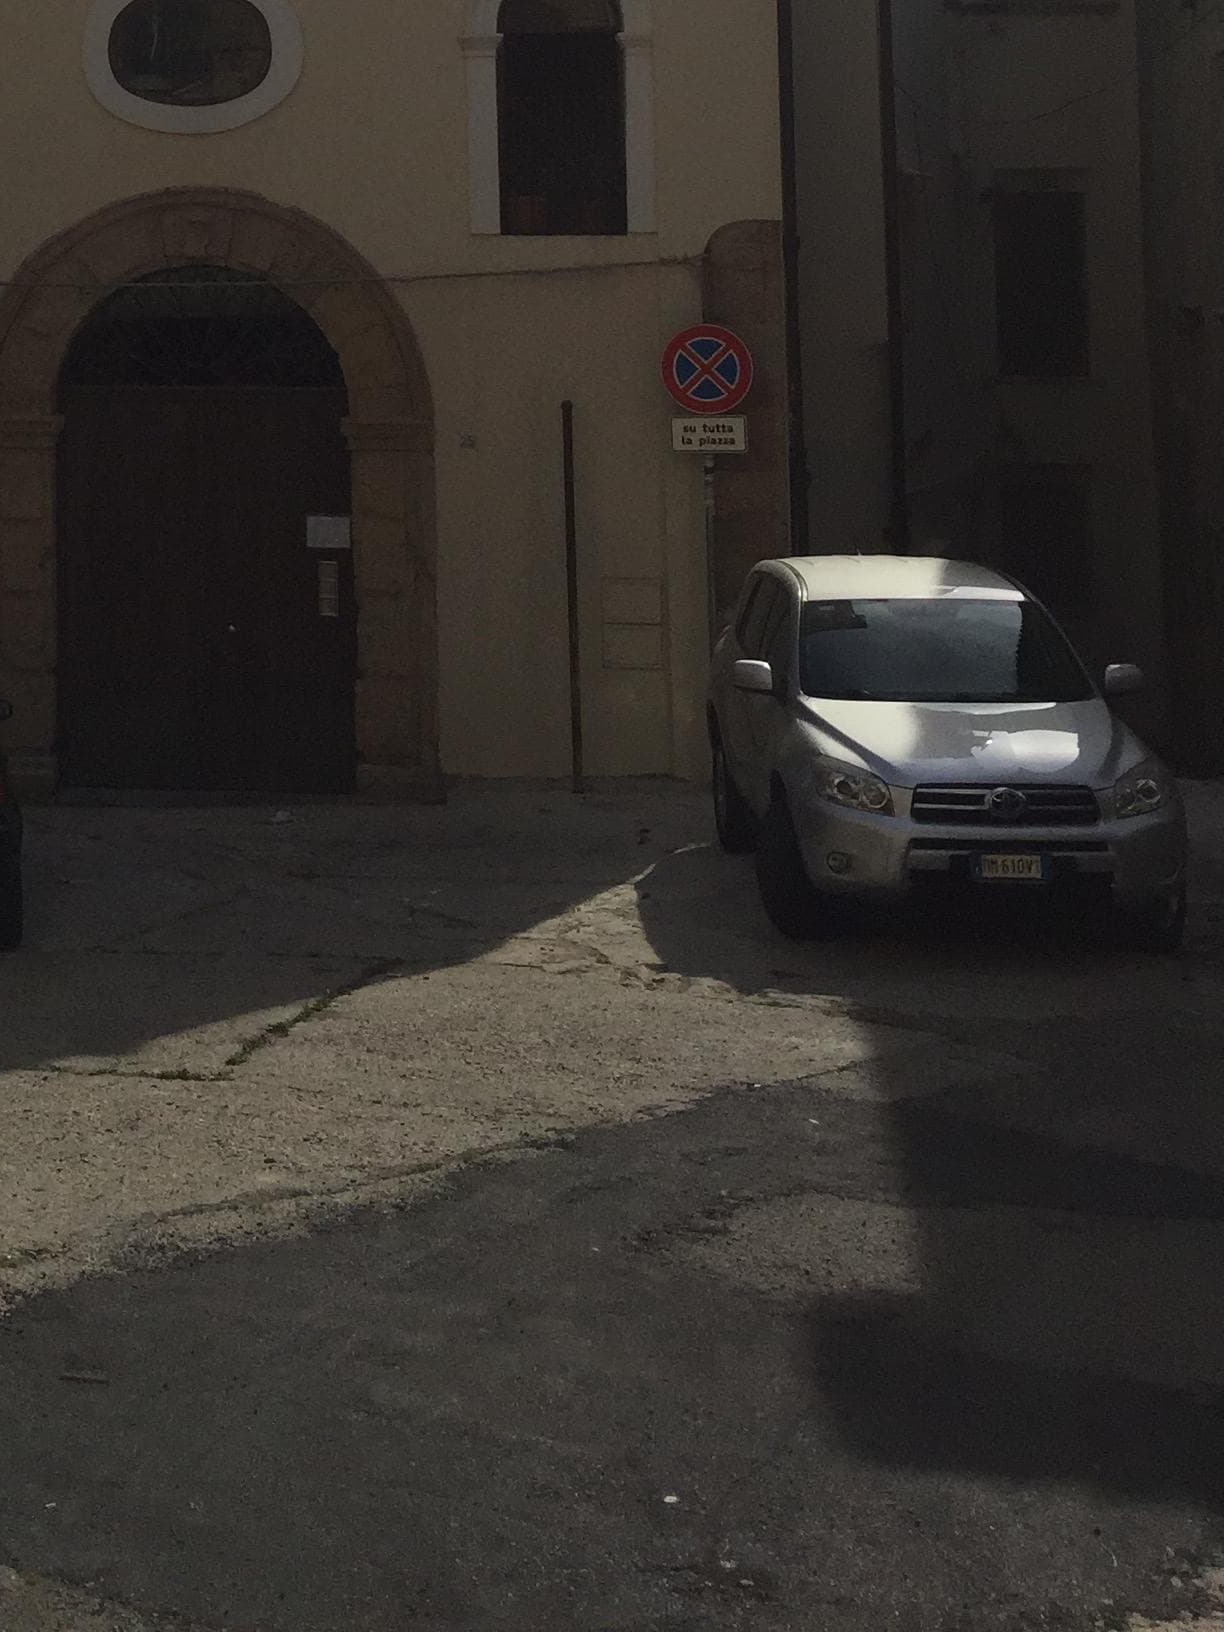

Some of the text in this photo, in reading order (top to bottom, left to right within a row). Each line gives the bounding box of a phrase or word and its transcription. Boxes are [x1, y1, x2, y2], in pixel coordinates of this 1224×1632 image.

[683, 423, 734, 433] su tutta
[681, 435, 736, 447] la piazza
